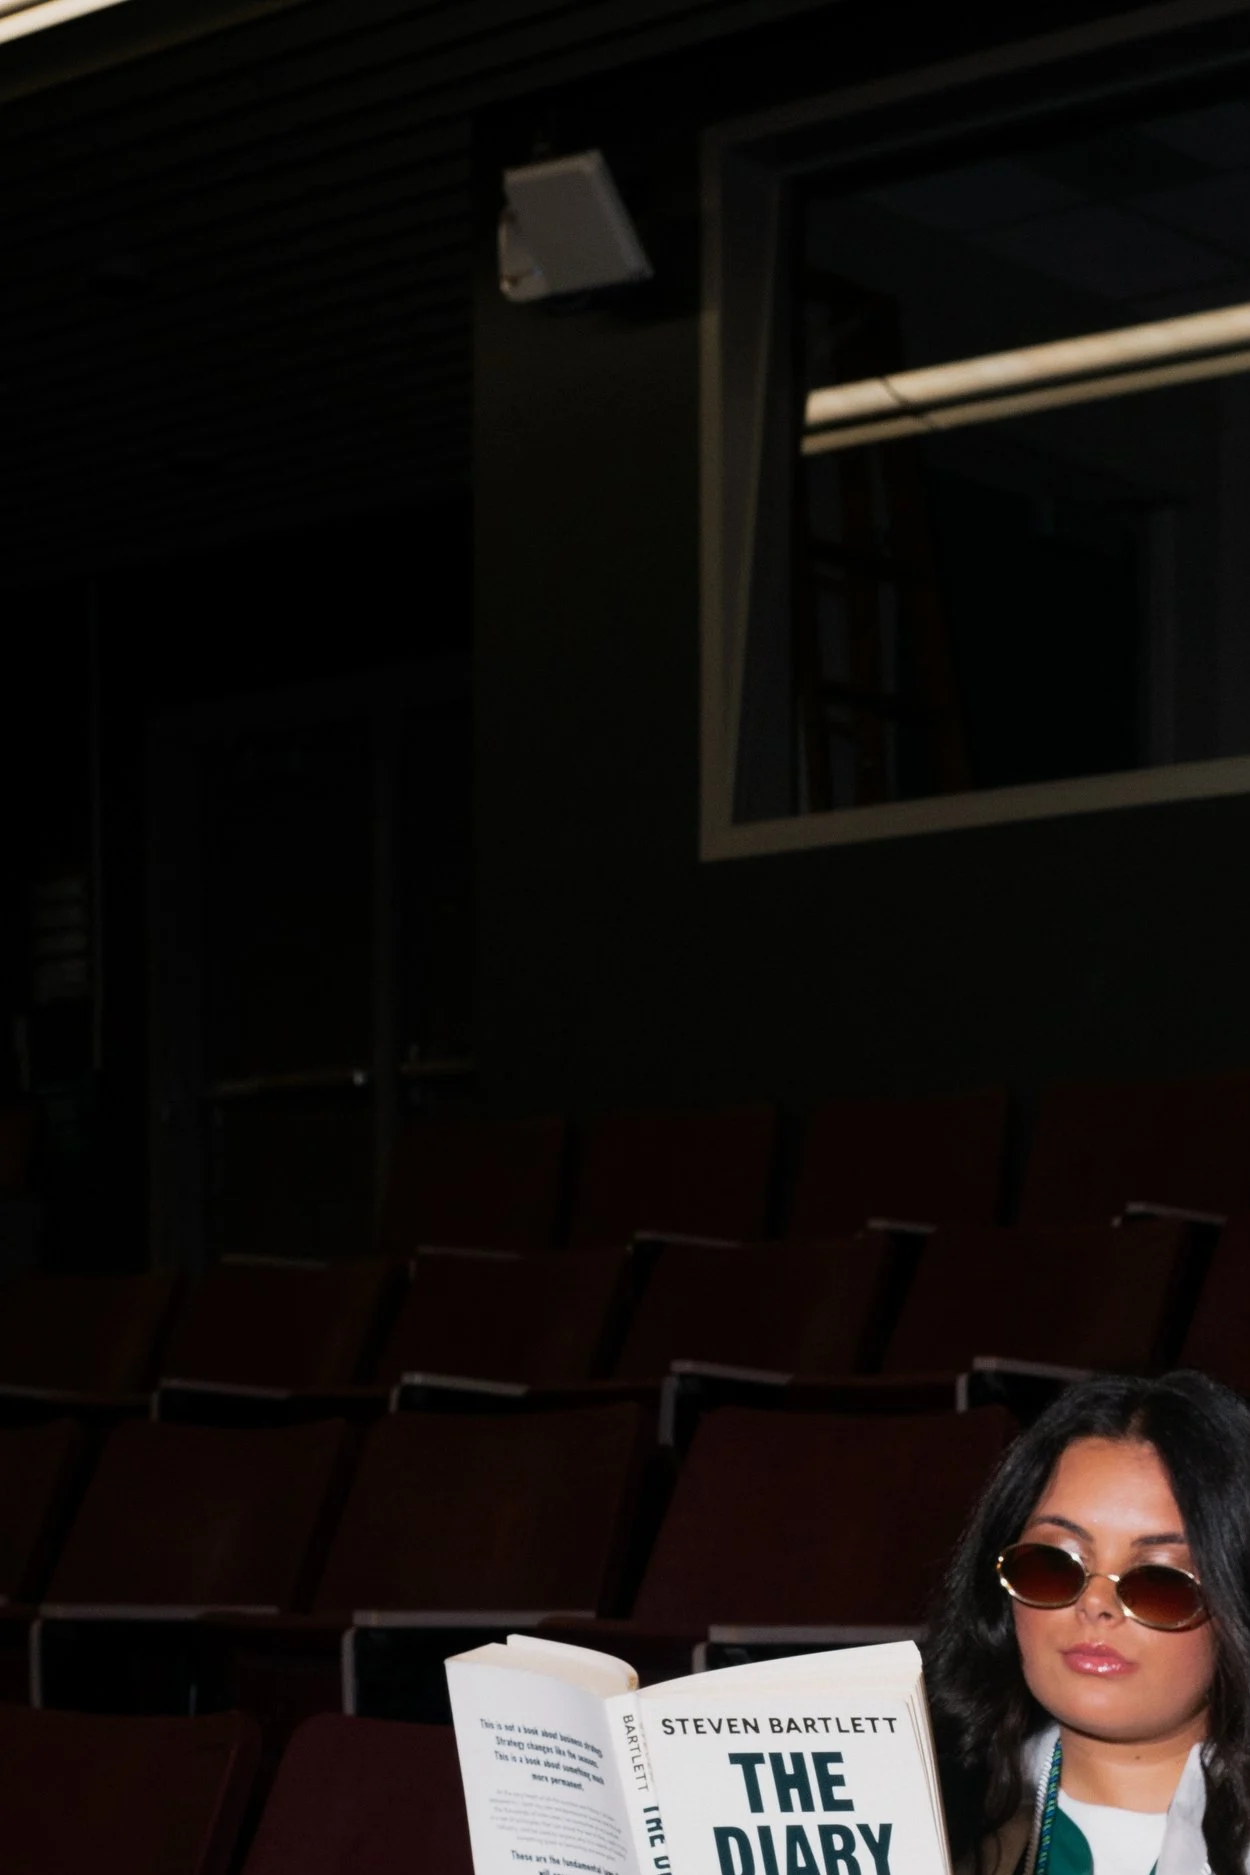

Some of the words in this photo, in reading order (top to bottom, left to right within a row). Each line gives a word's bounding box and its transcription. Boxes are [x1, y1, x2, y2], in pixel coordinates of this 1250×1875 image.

[622, 1714, 649, 1792] BARTLETT
[661, 1717, 761, 1736] STEVEN
[768, 1717, 897, 1735] BARTLETT
[728, 1751, 855, 1813] THE
